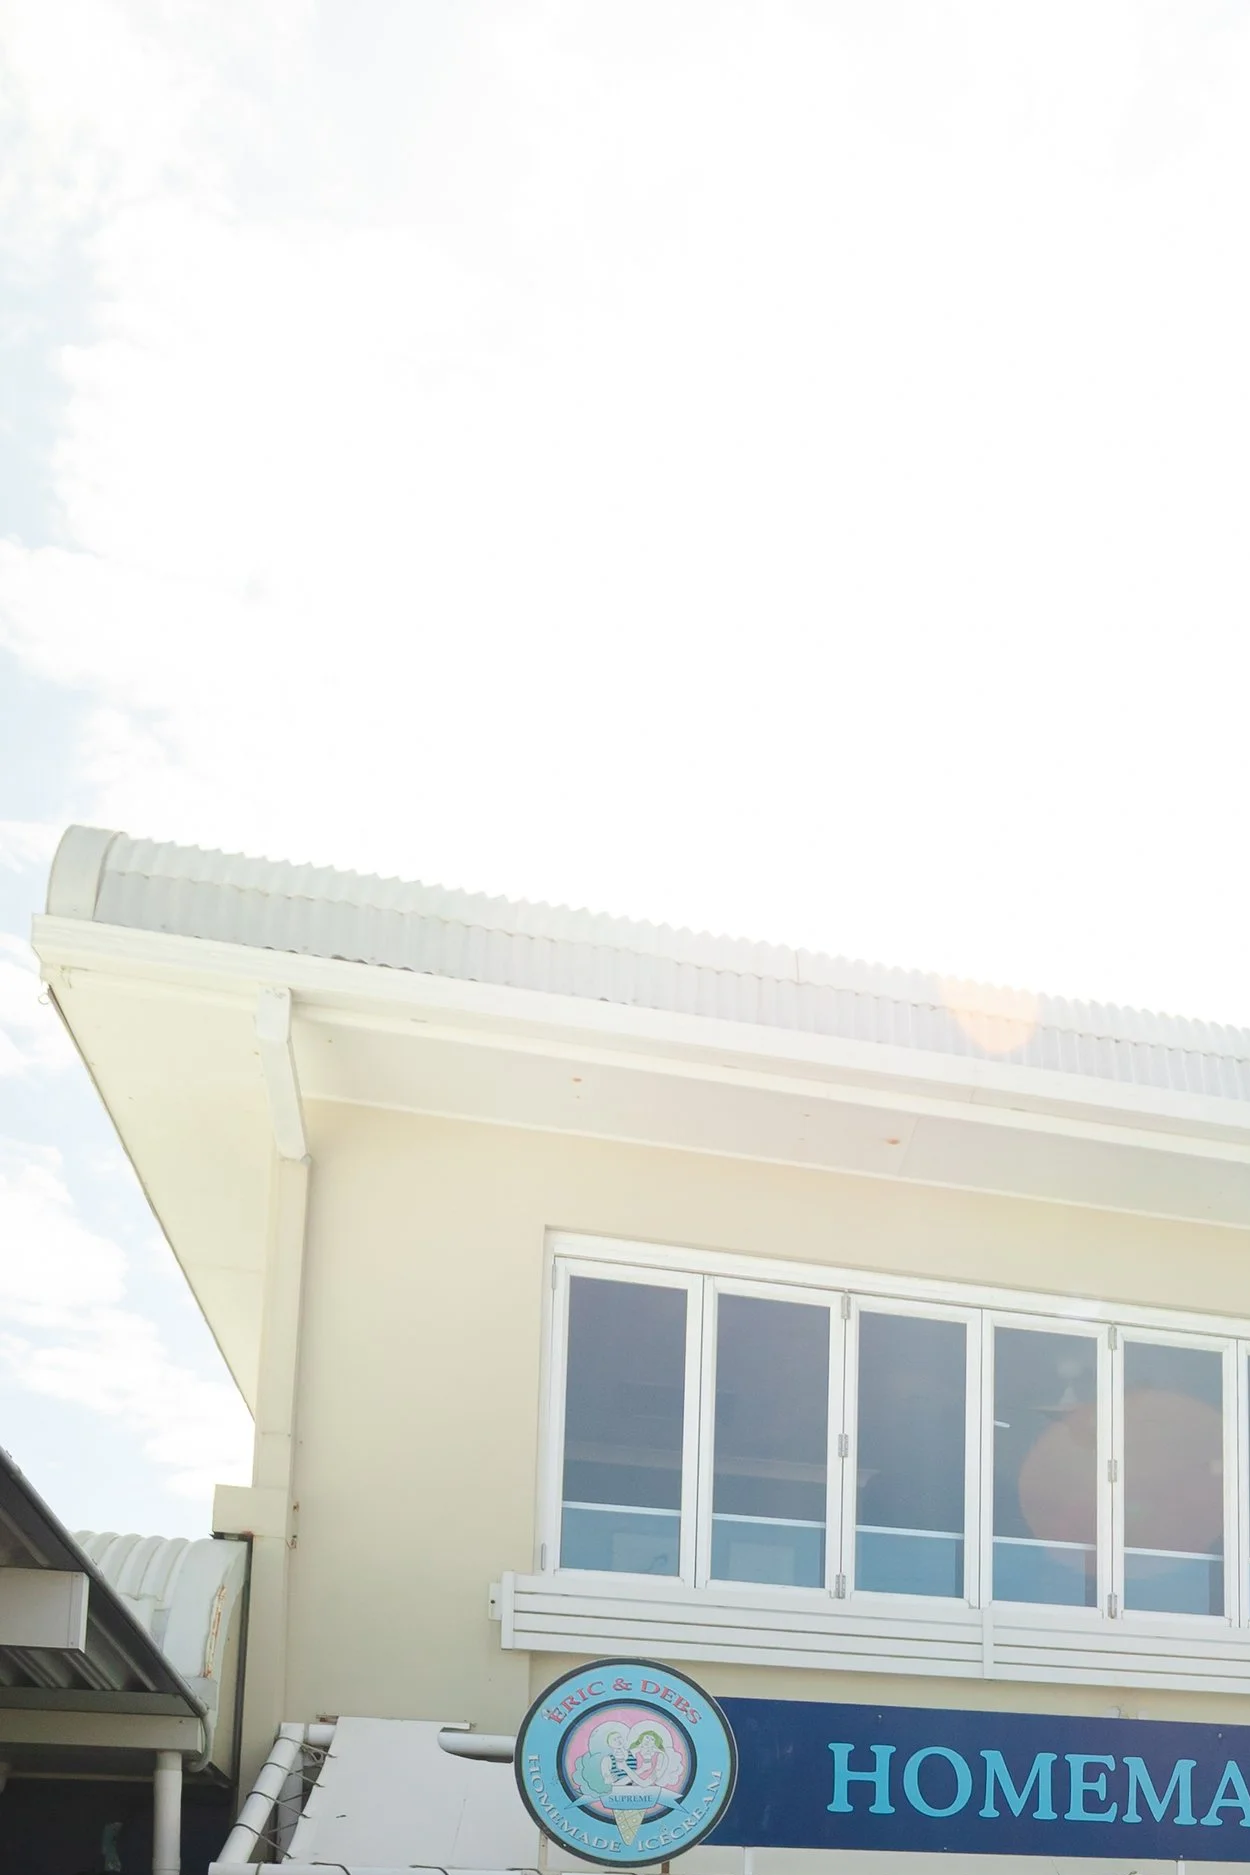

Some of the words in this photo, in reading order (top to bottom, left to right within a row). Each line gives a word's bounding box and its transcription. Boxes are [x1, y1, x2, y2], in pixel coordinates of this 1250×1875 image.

[612, 1678, 632, 1691] &
[640, 1679, 702, 1725] DEBS
[527, 1753, 622, 1853] HOMEMADE
[608, 1794, 653, 1803] SUPREME
